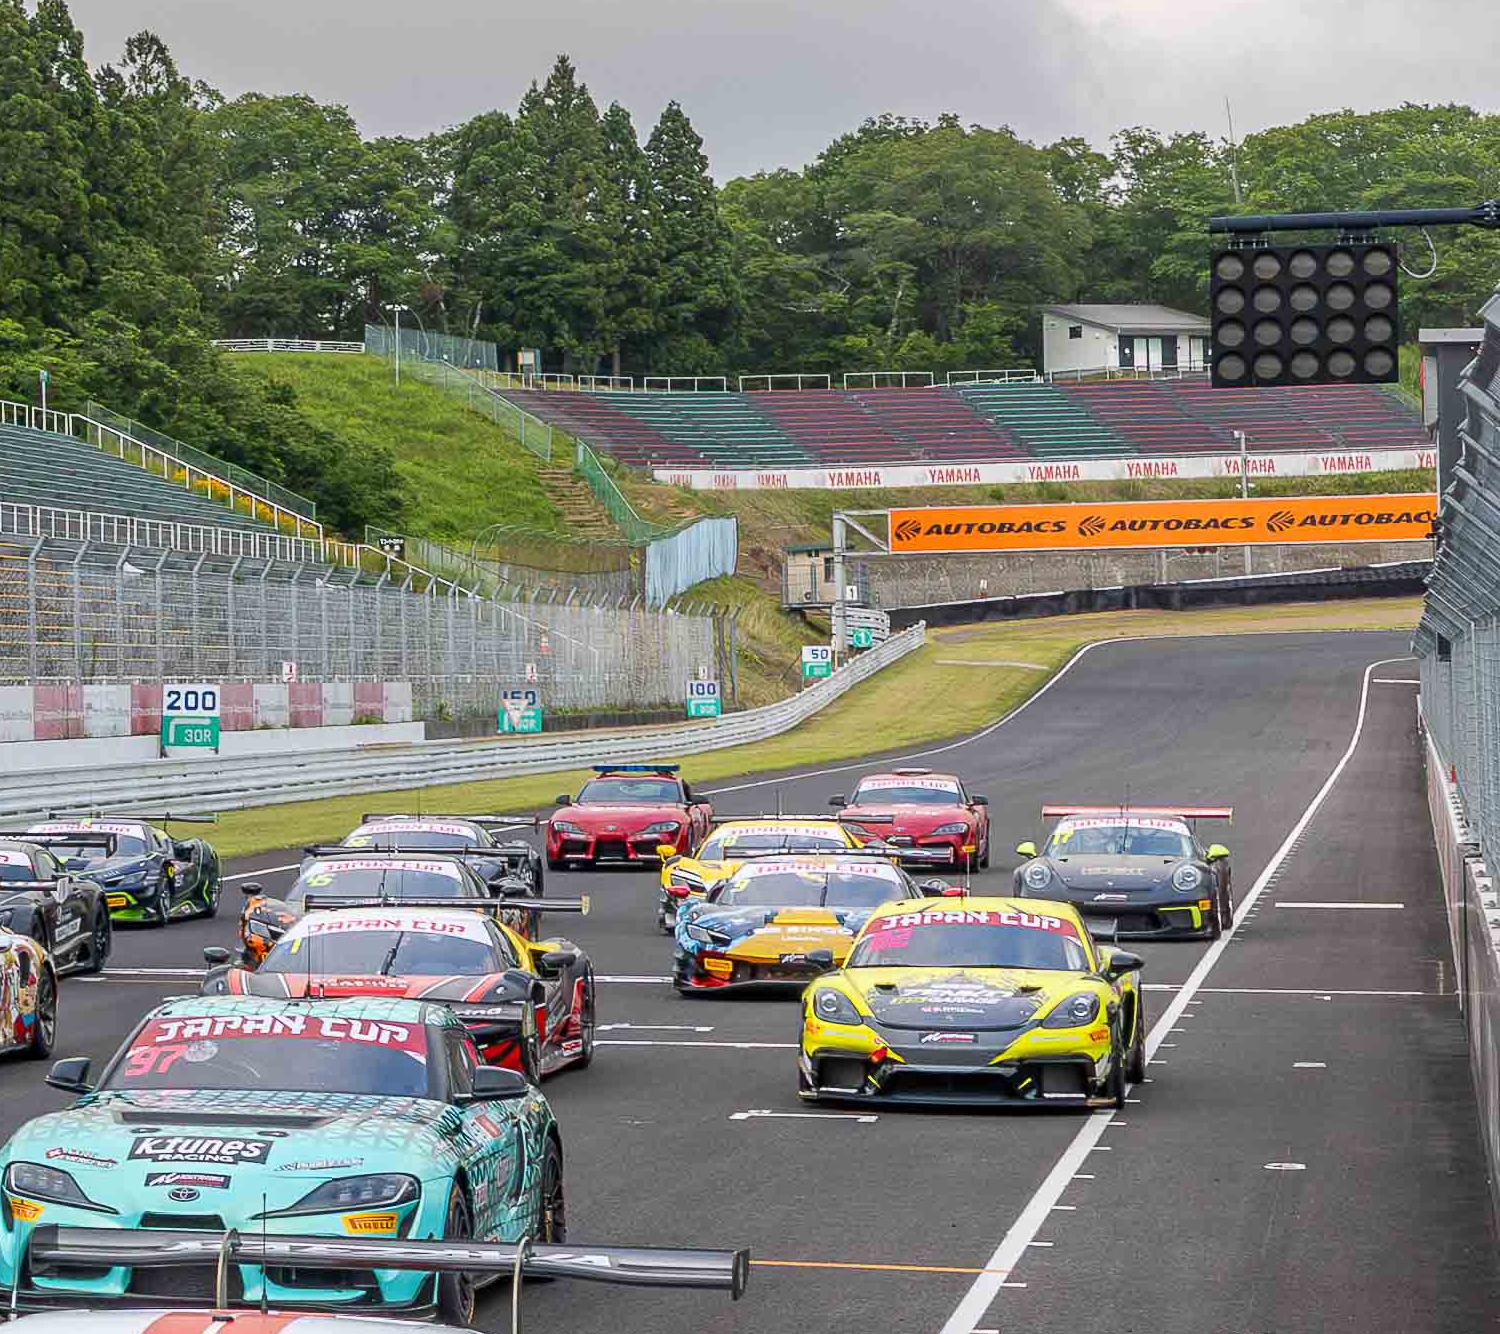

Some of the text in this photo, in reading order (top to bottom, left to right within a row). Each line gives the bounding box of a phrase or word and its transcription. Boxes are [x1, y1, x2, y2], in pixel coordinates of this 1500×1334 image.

[1126, 461, 1178, 477] YAMAHA
[1321, 455, 1373, 472] YAMAHA
[829, 471, 881, 486] YAMAHA
[928, 468, 981, 483] YAMAHA
[1027, 464, 1080, 480] YAMAHA
[924, 519, 1067, 536] AUTOBACS
[1111, 516, 1255, 533] AUTOBACS
[811, 649, 829, 660] 50
[689, 682, 717, 696] 100
[166, 690, 217, 711] 200
[183, 728, 212, 743] 30R
[314, 920, 467, 933] JAPAN CUP
[882, 911, 1062, 931] JAPAN CUP
[153, 1014, 410, 1044] JAPAN CUP
[124, 1045, 188, 1075] 97
[135, 1137, 266, 1159] ktunes
[158, 1153, 235, 1164] RACING
